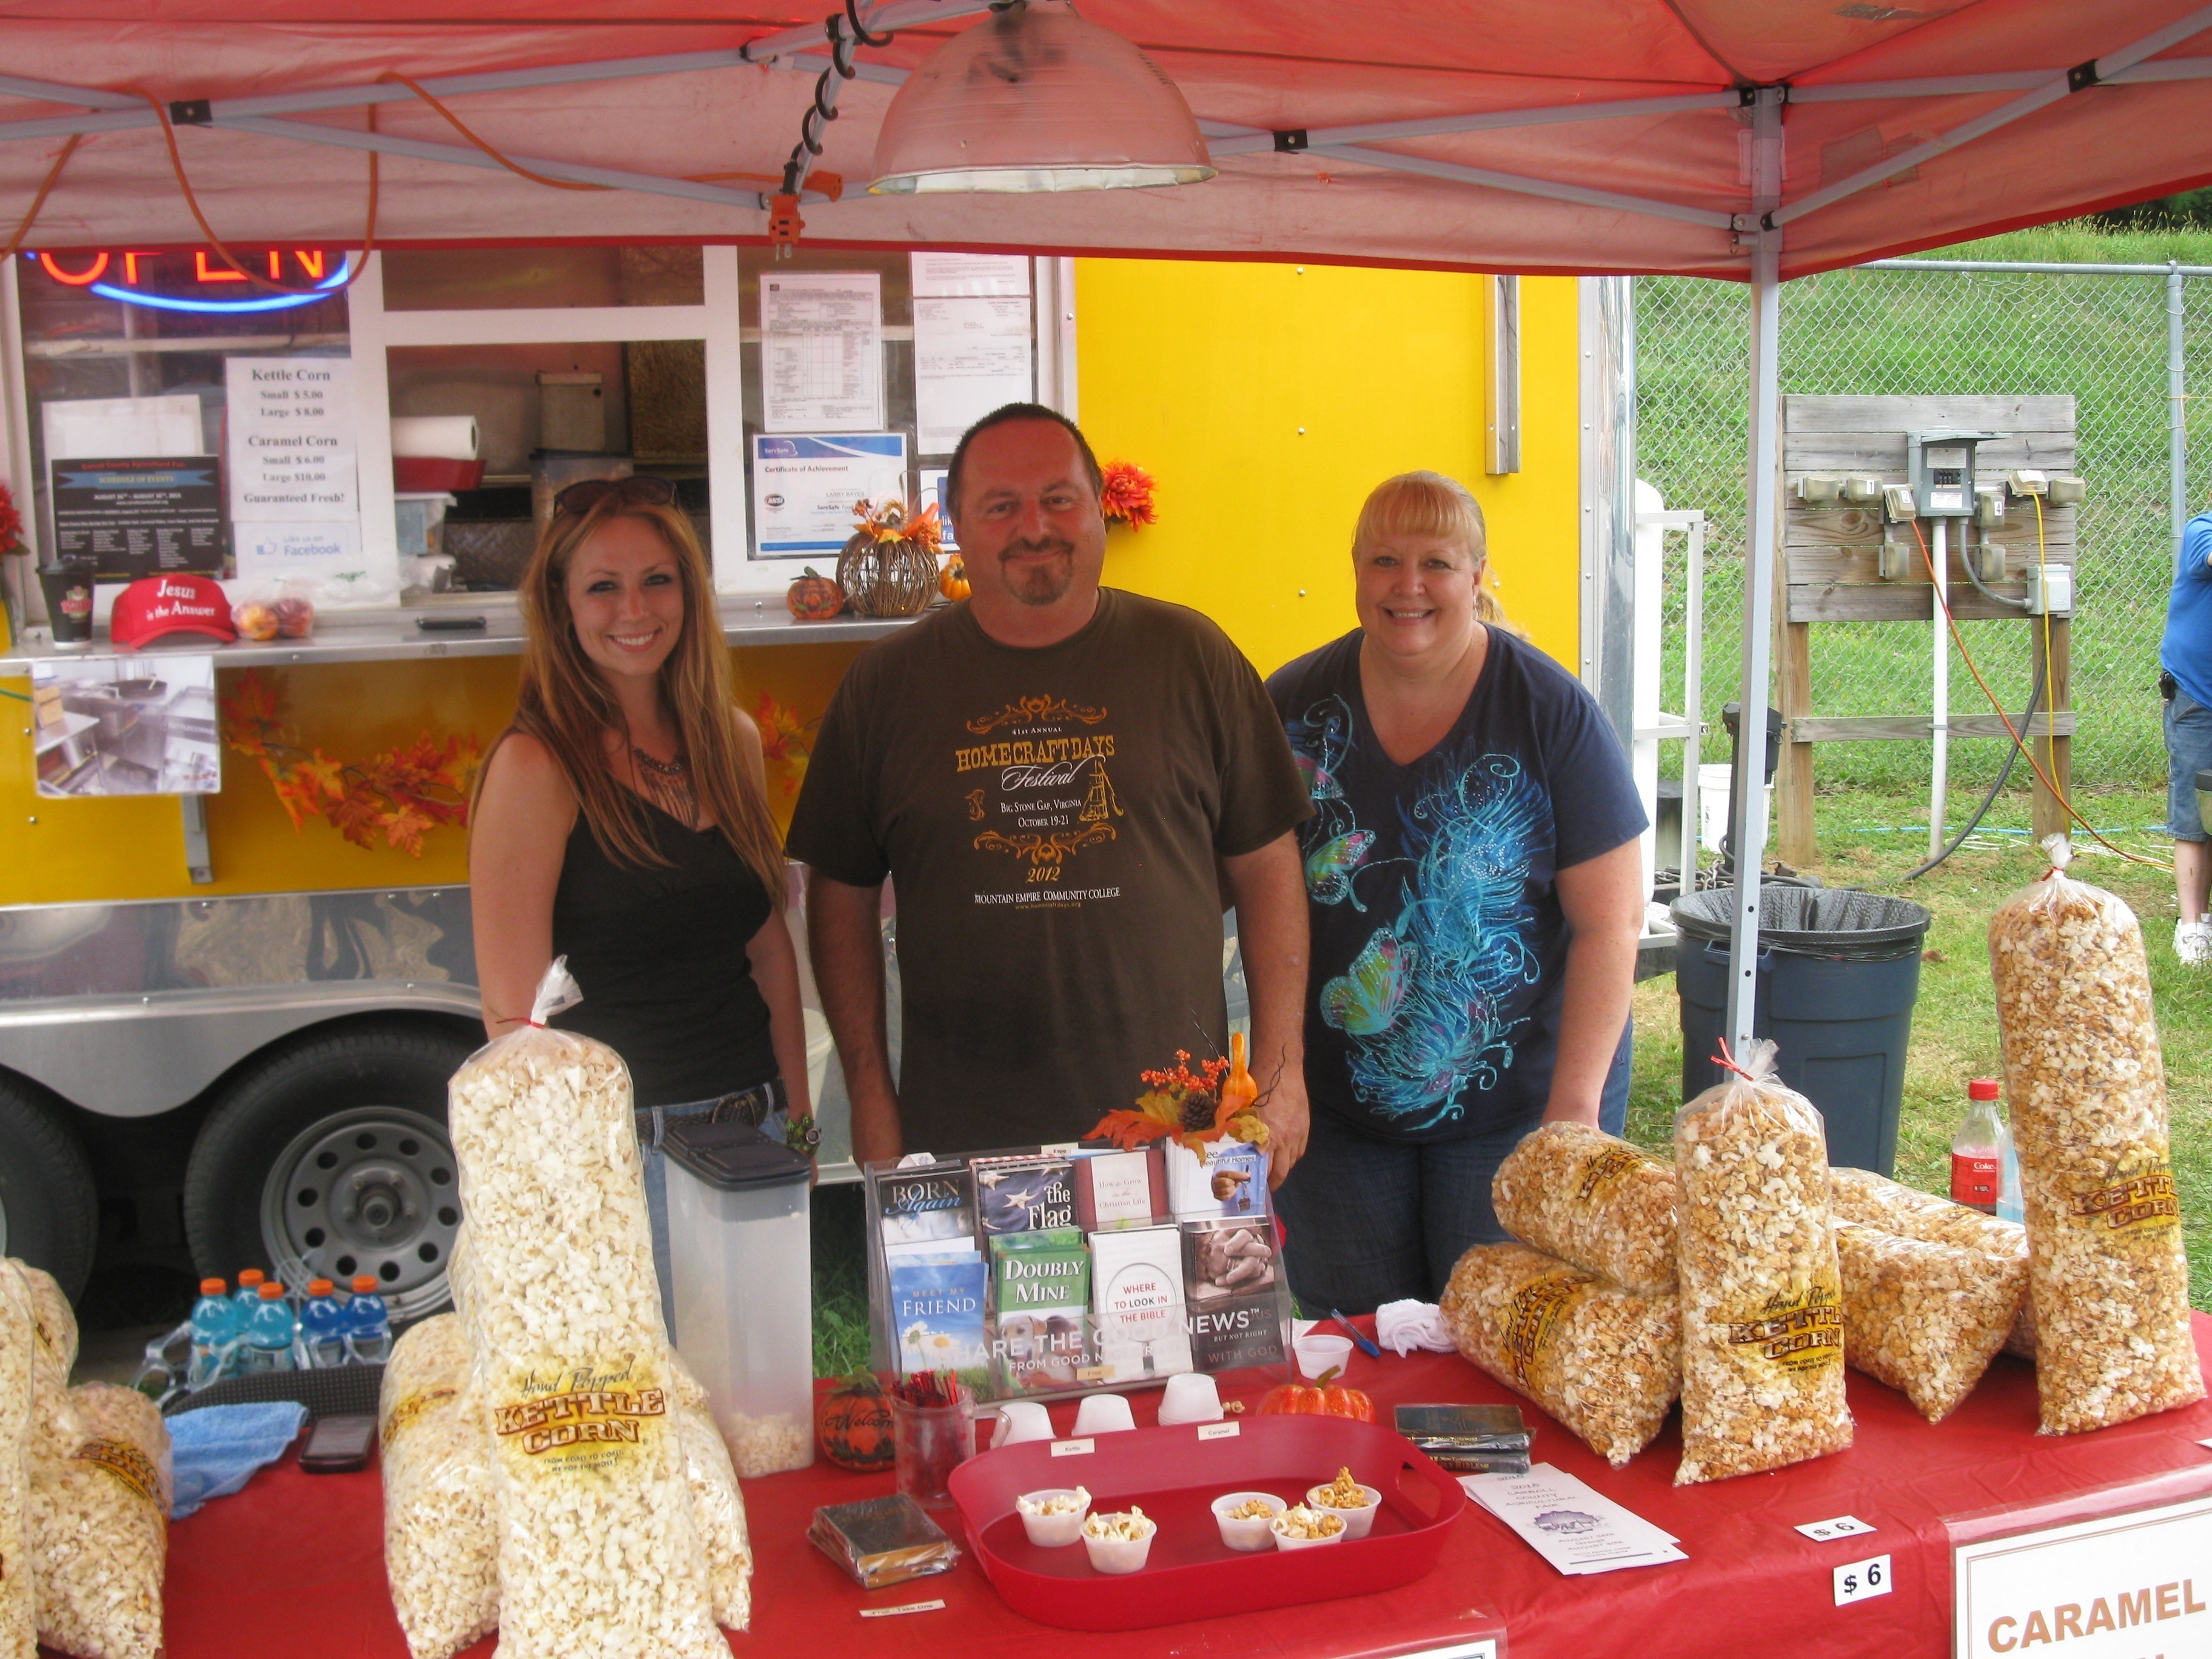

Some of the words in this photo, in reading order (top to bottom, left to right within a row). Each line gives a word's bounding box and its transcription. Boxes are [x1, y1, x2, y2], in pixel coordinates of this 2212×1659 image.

[252, 369, 292, 380] Kettle
[297, 369, 330, 380] Corn
[261, 390, 289, 399] Small
[294, 390, 300, 400] $
[261, 407, 290, 418] Large
[296, 407, 301, 416] $
[304, 407, 324, 416] 8.00
[248, 435, 302, 446] Caramel
[306, 435, 338, 446] Corn
[263, 456, 290, 464] Small
[297, 456, 301, 465] $
[305, 456, 325, 464] 6.00
[263, 473, 291, 483] Large
[1869, 481, 1873, 494] 1
[244, 493, 307, 503] Guaranteed
[310, 493, 344, 503] Fresh!
[1902, 492, 1908, 502] 2
[1996, 501, 2001, 515] 4
[284, 545, 341, 556] Facebook
[156, 580, 195, 600] Jesus
[146, 610, 154, 620] is
[155, 606, 170, 617] the
[171, 600, 216, 617] Answer
[1071, 734, 1115, 760] DAYS
[1001, 754, 1106, 791] Festival
[1018, 817, 1049, 828] OCTOBER
[1050, 815, 1070, 826] 19-21
[1025, 866, 1061, 883] 2012
[974, 891, 1014, 904] MOUNTAIN
[1016, 890, 1041, 902] EMPIRE
[1043, 888, 1088, 902] COMMUNITY
[1088, 886, 1121, 900] COLLEGE
[1204, 1157, 1230, 1165] eautiful
[892, 1179, 959, 1204] BORN
[1044, 1181, 1071, 1204] the
[885, 1190, 962, 1218] Again
[1099, 1199, 1130, 1209] Christian
[1028, 1201, 1071, 1230] Flag
[1005, 1259, 1084, 1281] DOUBLY
[913, 1289, 943, 1298] MEET
[1016, 1282, 1071, 1304] MINE
[1122, 1282, 1156, 1293] WHERE
[903, 1298, 976, 1316] FRIEND
[1114, 1301, 1127, 1310] TO
[1129, 1298, 1155, 1308] LOOK
[1157, 1295, 1167, 1304] IN
[1120, 1314, 1138, 1323] THE
[1141, 1310, 1166, 1321] BIBLE
[1728, 1305, 1843, 1344] KETTL
[1213, 1334, 1228, 1342] BUT
[1229, 1332, 1243, 1341] NOT
[1245, 1330, 1268, 1339] RIGHT
[1763, 1327, 1842, 1359] CORN
[952, 1338, 1025, 1361] HARE
[1034, 1331, 1082, 1353] THE
[1208, 1350, 1242, 1363] WITH
[1247, 1344, 1278, 1357] GOD
[1009, 1359, 1046, 1372] FROM
[1051, 1354, 1090, 1366] GOOD
[520, 1369, 561, 1396] Hand
[568, 1359, 635, 1393] Popped
[495, 1387, 665, 1436] KETTLE
[825, 1409, 893, 1430] Welcom
[523, 1419, 640, 1455] CORN
[594, 1458, 618, 1467] MOST!
[1506, 1495, 1579, 1506] AGRICULTURAL
[1812, 1527, 1832, 1537] $
[1834, 1521, 1855, 1532] 6
[1844, 1574, 1857, 1595] $
[1867, 1563, 1881, 1586] 6
[1988, 1578, 2206, 1654] CARAMEL
